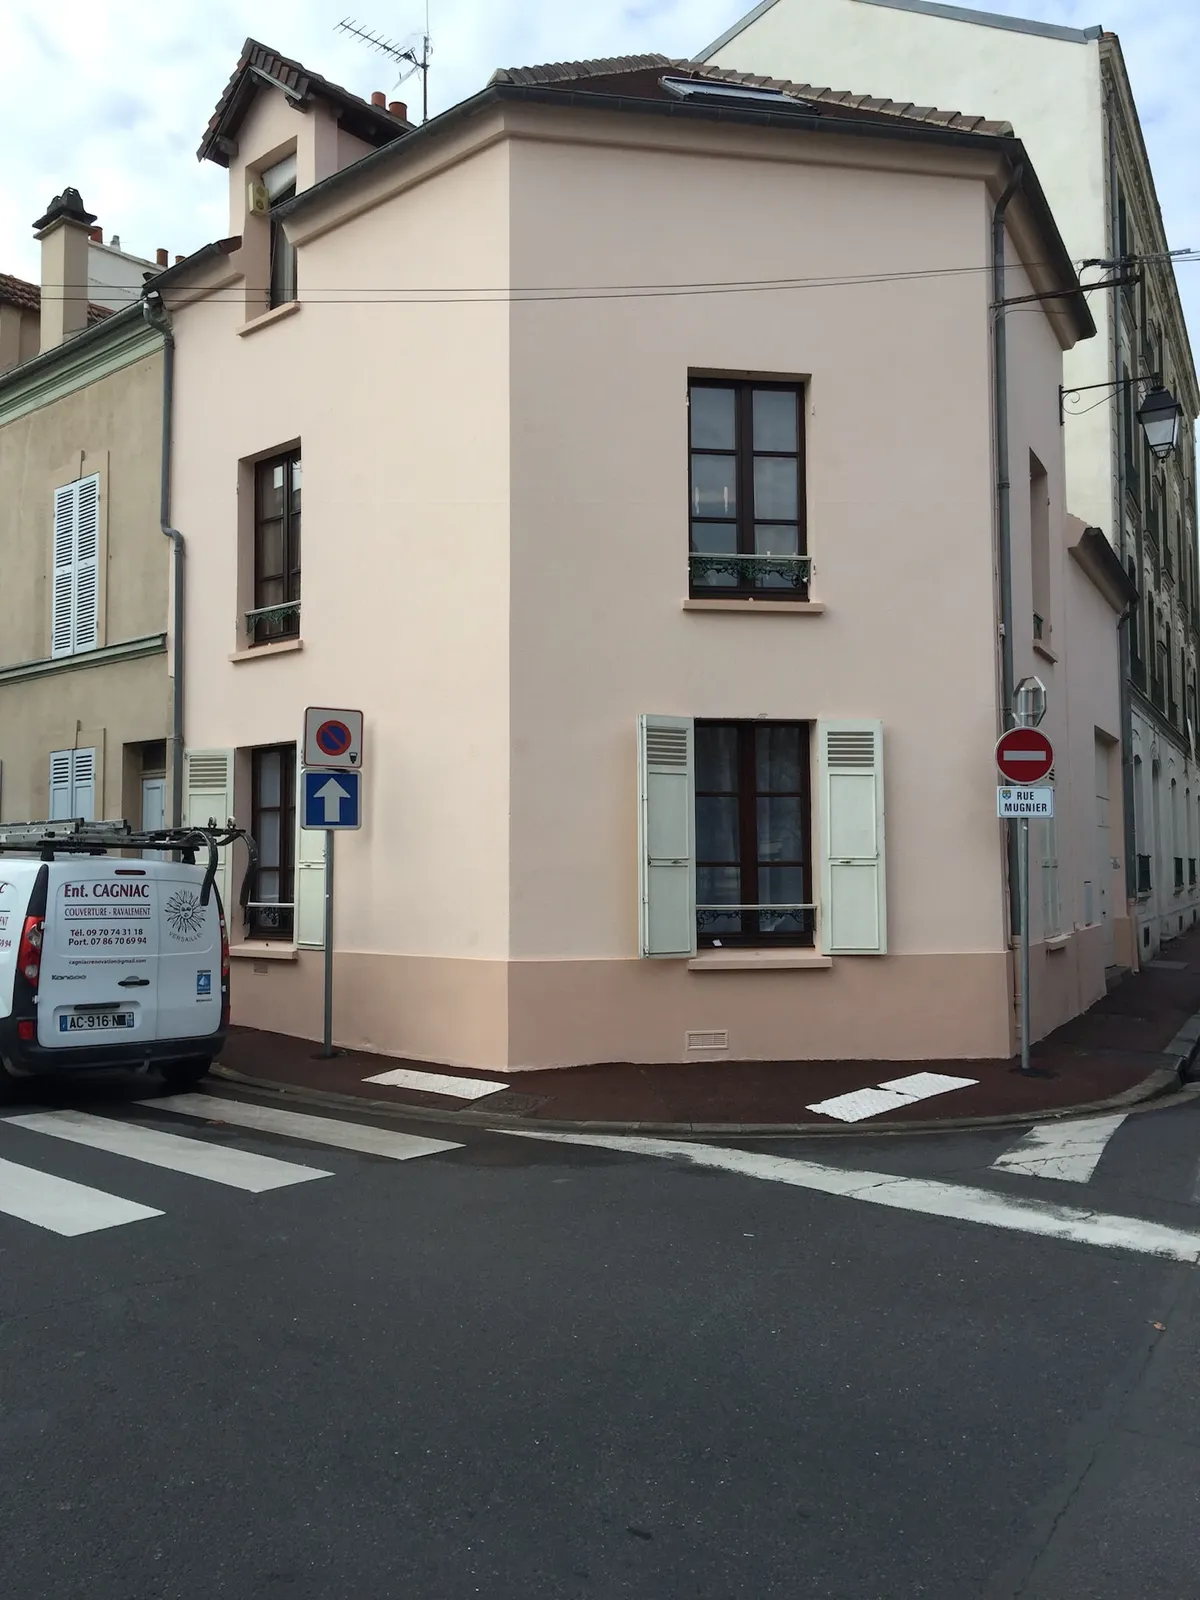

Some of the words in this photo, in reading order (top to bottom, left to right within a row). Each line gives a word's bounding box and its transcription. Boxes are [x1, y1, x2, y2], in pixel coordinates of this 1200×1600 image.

[1017, 792, 1034, 800] RUE
[1004, 803, 1047, 812] MUGNIER
[64, 884, 88, 898] Ent.
[93, 883, 150, 898] CAGNIAC
[64, 907, 107, 917] COUVERTURE
[113, 907, 151, 916] RAVALEMENT
[70, 929, 84, 937] Tél.
[68, 938, 88, 946] Port.
[126, 937, 136, 945] 69
